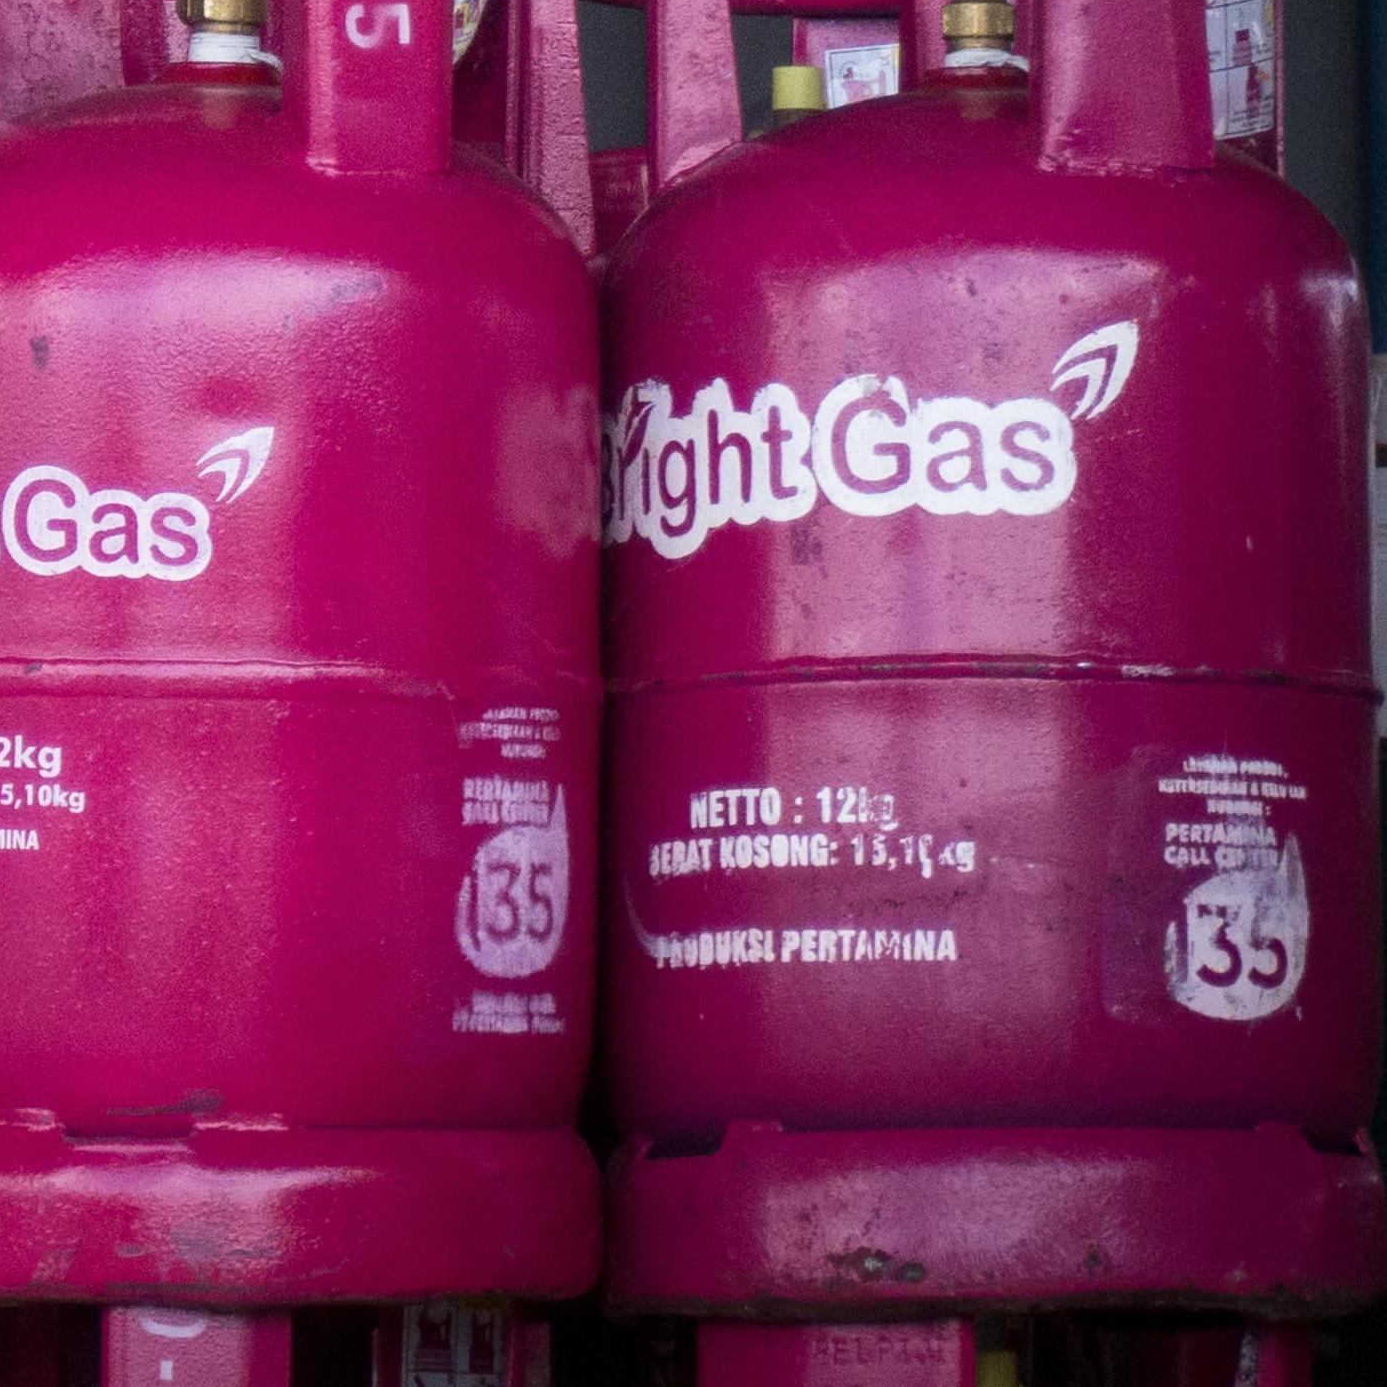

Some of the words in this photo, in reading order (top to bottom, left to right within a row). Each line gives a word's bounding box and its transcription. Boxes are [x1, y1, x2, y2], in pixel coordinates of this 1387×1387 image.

[812, 374, 1077, 516] Gas
[2, 464, 212, 582] Gas
[689, 787, 783, 830] NETTO
[780, 928, 958, 963] PERTAMINA
